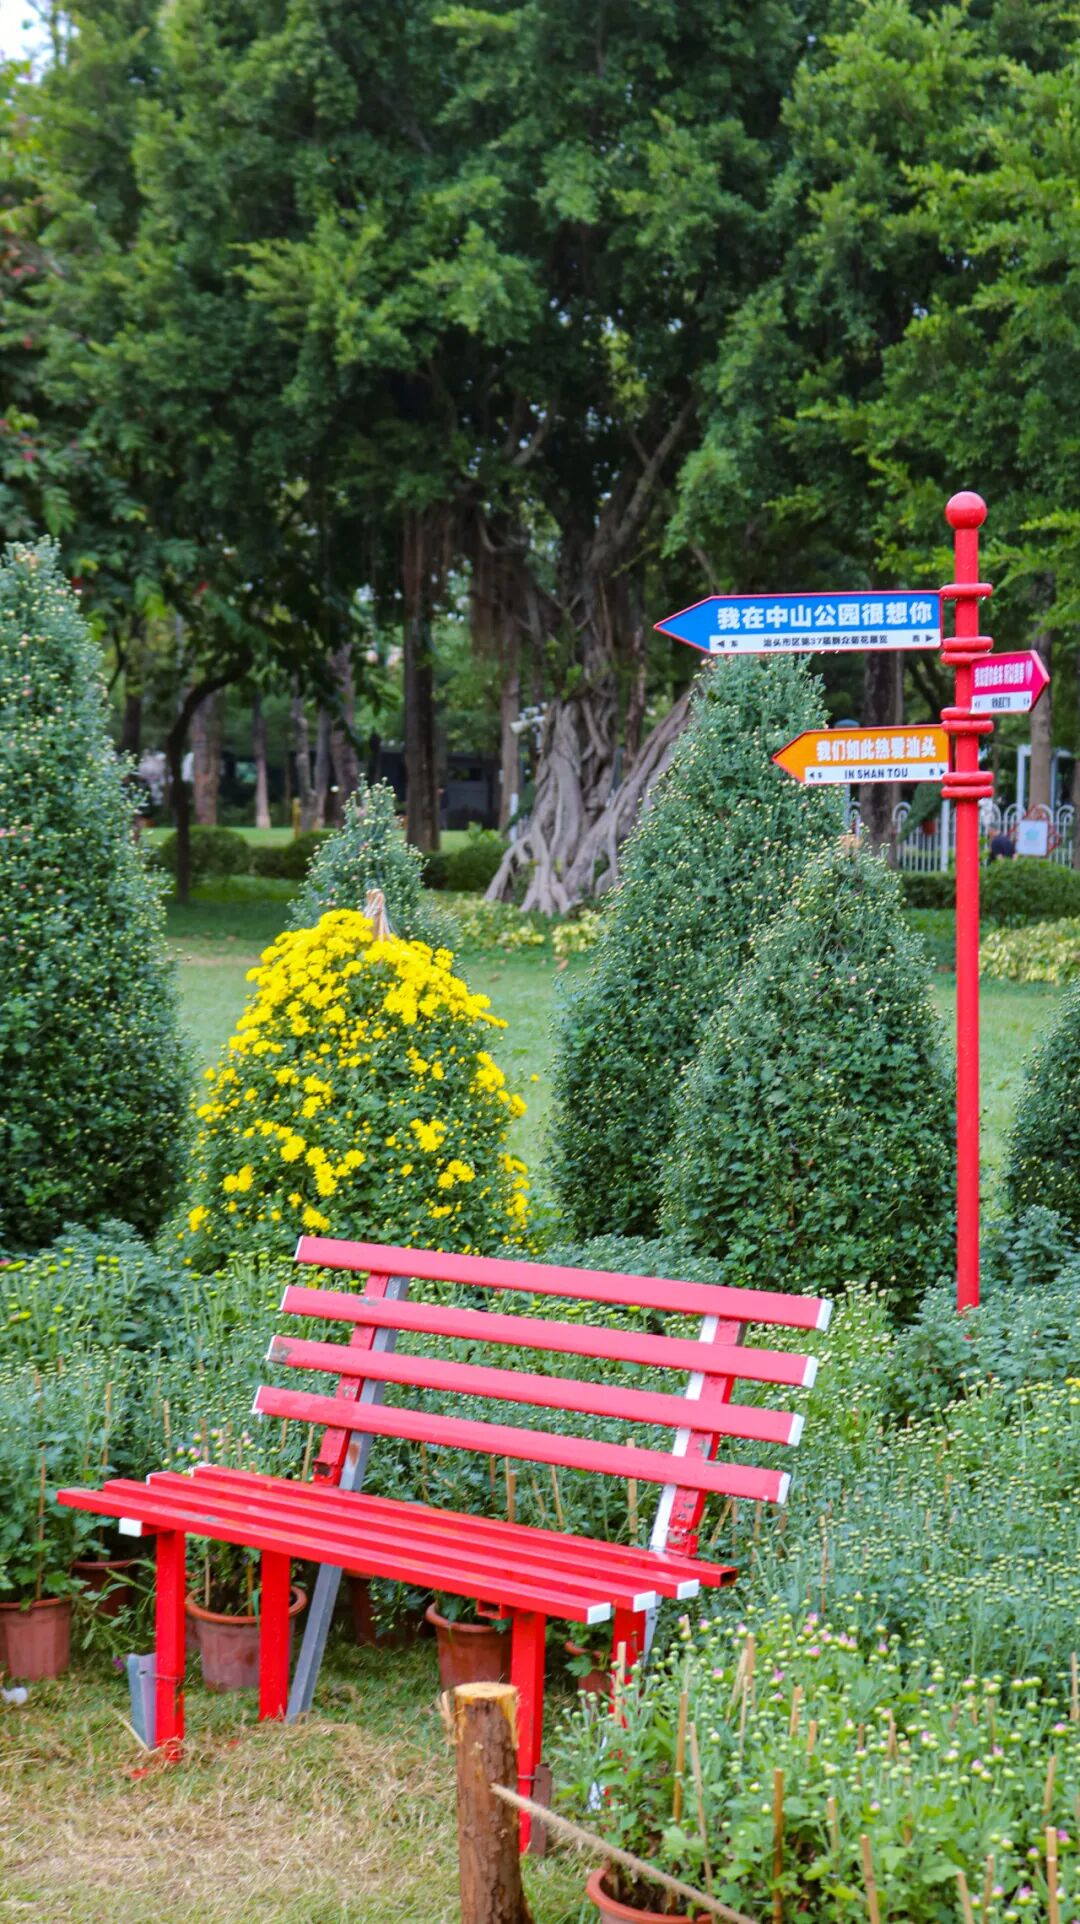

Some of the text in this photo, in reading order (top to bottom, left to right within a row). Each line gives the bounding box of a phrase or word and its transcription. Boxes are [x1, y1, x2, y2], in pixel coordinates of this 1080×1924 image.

[717, 601, 932, 629] 我在中山公园很想你
[816, 735, 936, 761] 我们如此热爱汕头
[858, 768, 885, 779] SHAN
[887, 767, 909, 779] TOU
